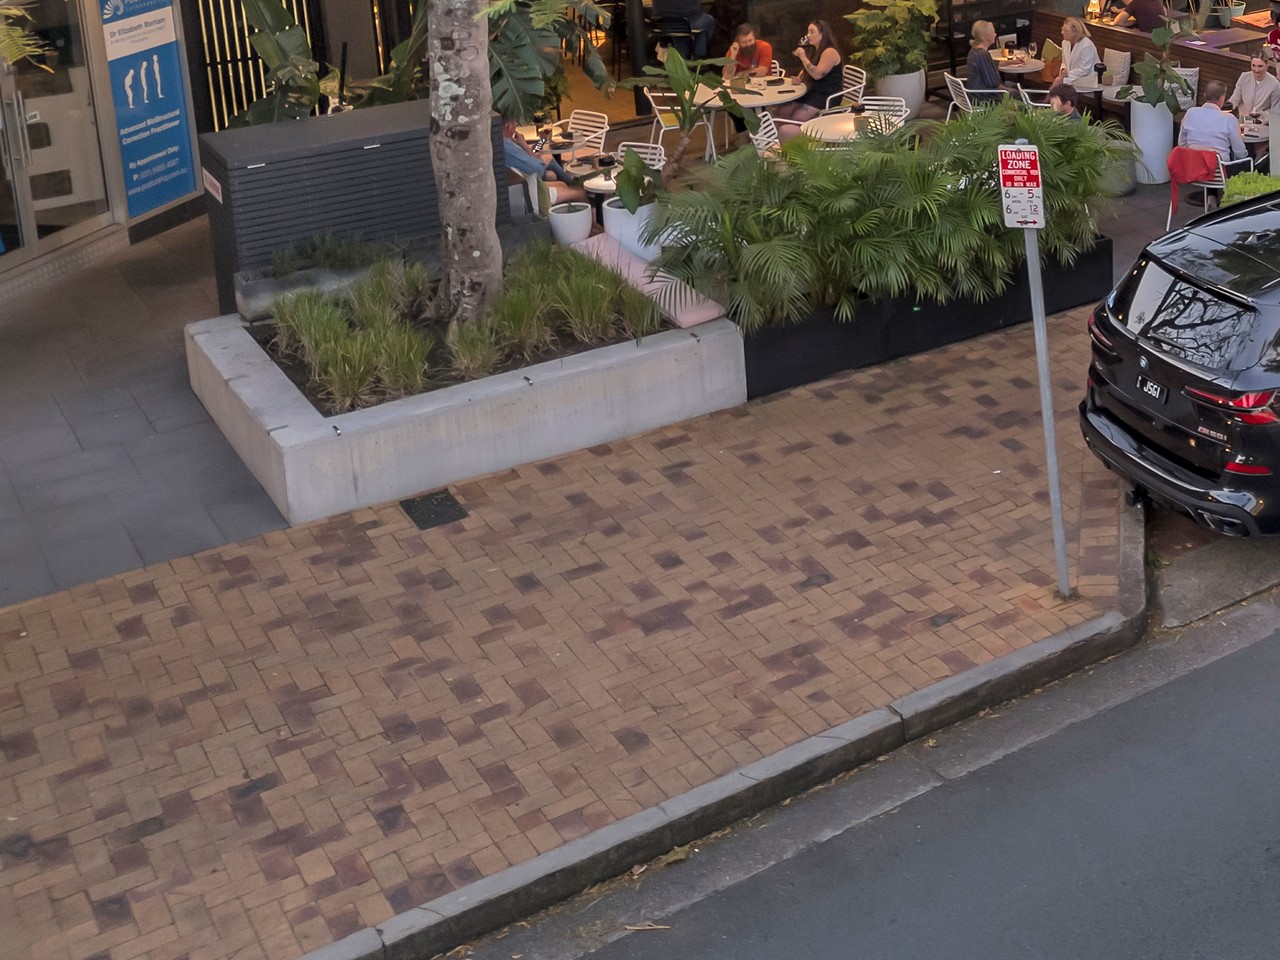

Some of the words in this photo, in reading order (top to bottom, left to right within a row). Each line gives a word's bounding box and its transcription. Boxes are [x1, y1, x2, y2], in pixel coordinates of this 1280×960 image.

[1002, 151, 1036, 160] LOADING
[1007, 160, 1032, 169] ZONE
[1004, 189, 1010, 199] 6
[1027, 189, 1034, 199] 5
[1005, 204, 1012, 214] 6
[1029, 204, 1038, 212] 12
